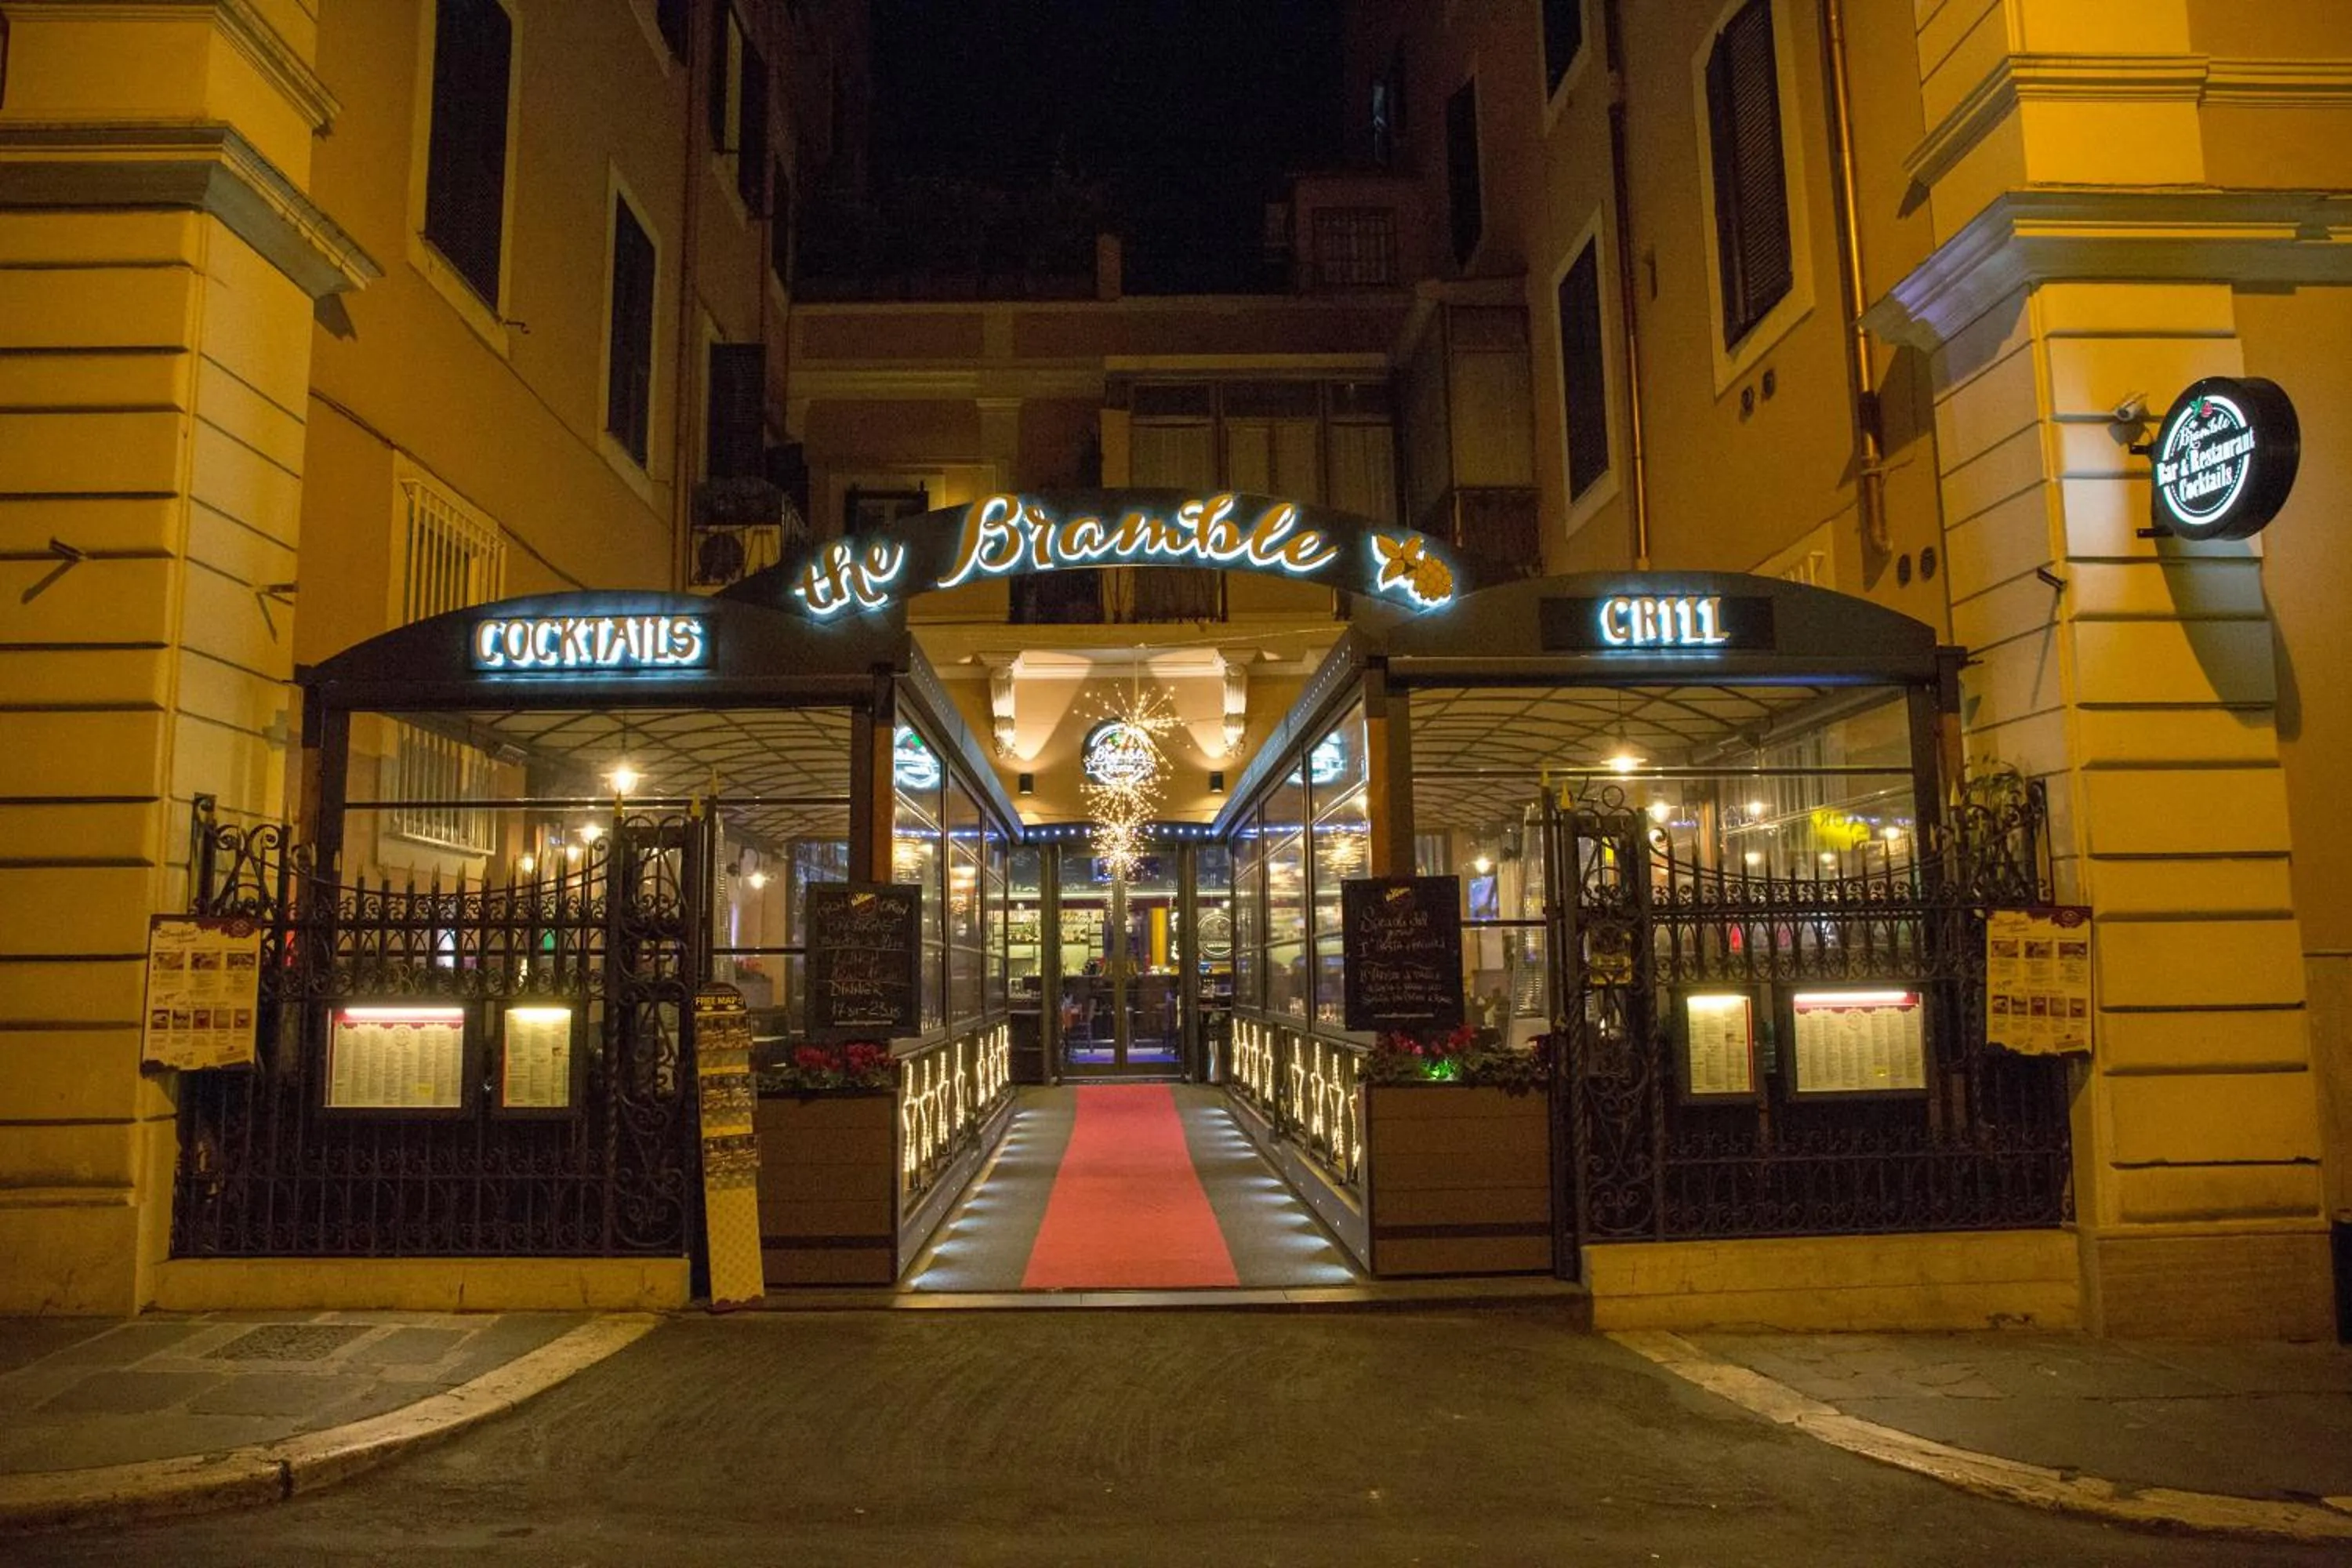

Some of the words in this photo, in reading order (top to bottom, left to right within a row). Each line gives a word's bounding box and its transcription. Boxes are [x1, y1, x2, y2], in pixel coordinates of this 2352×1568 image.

[2156, 461, 2179, 487] Bar
[2186, 426, 2256, 474] Restaurant
[2179, 463, 2233, 502] Cocktails
[795, 541, 904, 615] the
[937, 493, 1339, 589] Bramble
[475, 616, 702, 667] COCKTAILS
[1599, 596, 1731, 645] GRILL
